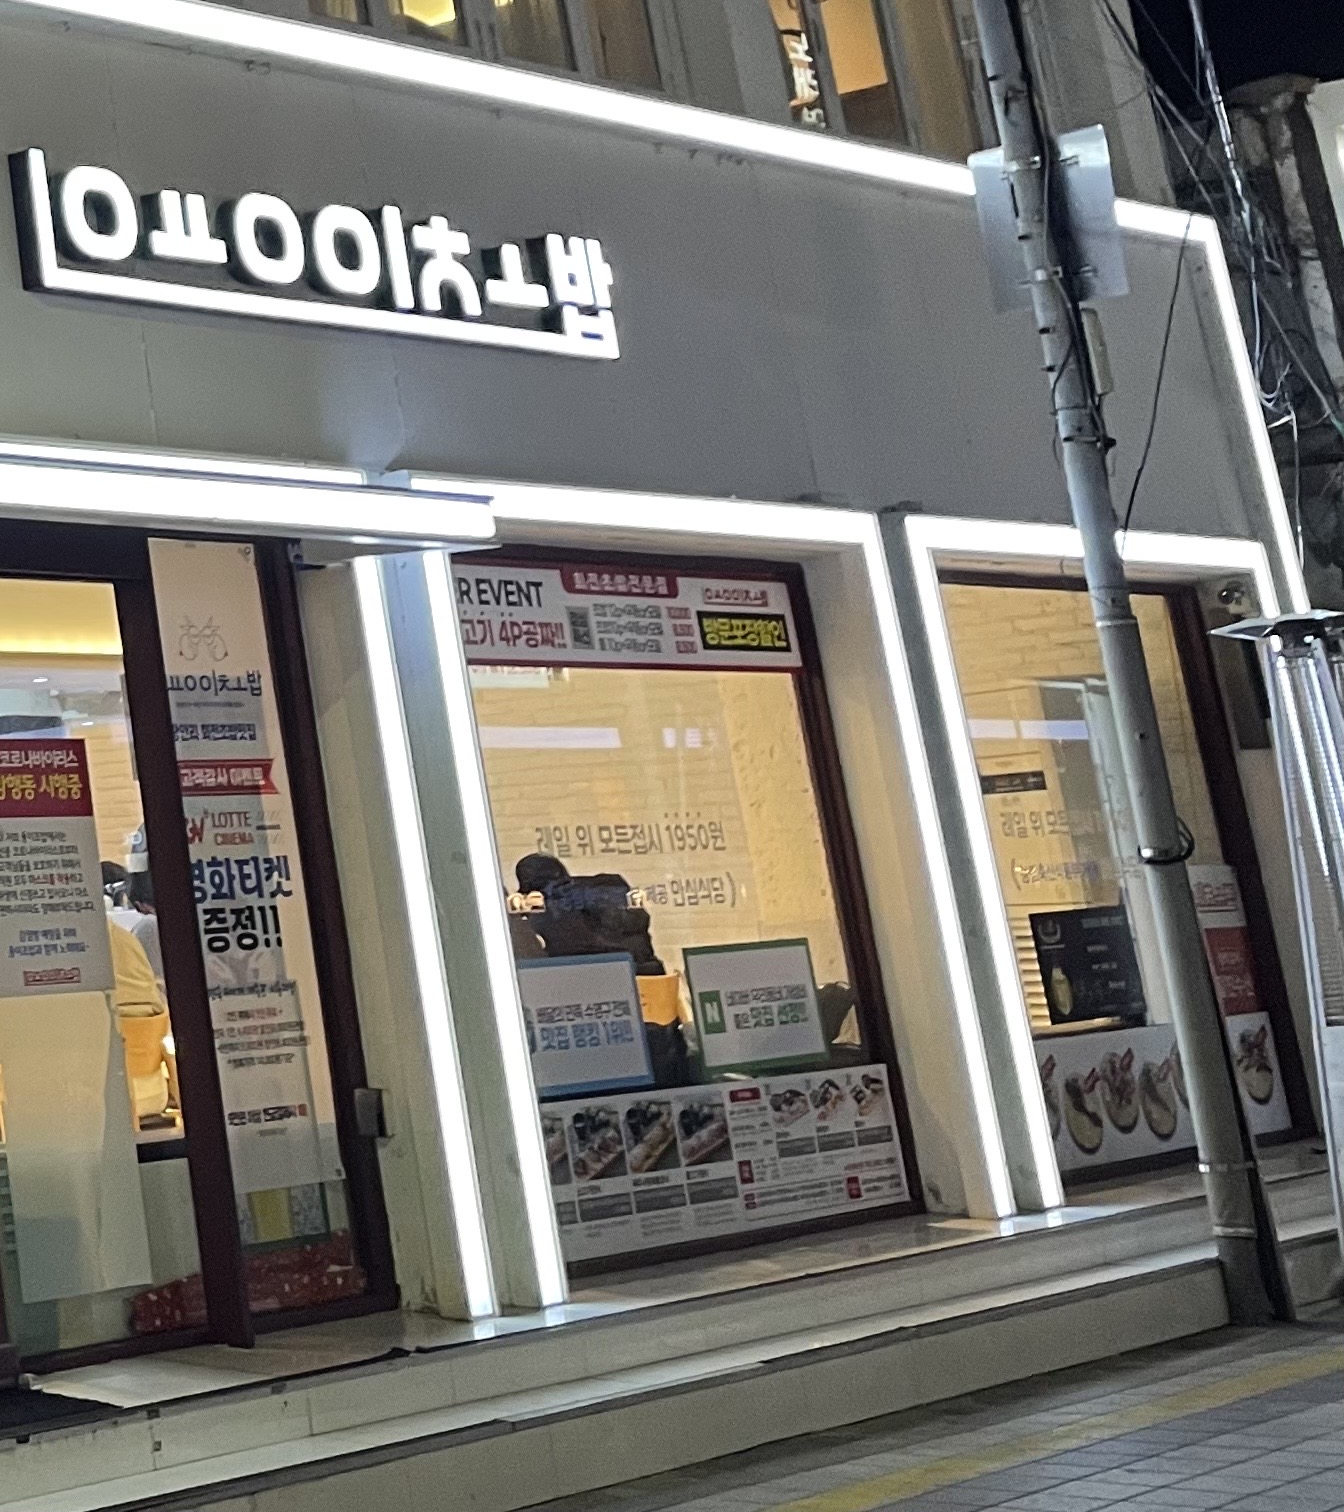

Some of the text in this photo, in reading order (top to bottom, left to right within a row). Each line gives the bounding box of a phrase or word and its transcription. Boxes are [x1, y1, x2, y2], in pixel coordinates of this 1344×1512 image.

[475, 577, 543, 608] EVENT
[0, 749, 80, 769] 코로나바이러스
[211, 811, 252, 829] LOTTE
[214, 831, 255, 846] CINEMA
[575, 824, 595, 856] 위
[598, 822, 663, 855] 모든접시
[664, 820, 727, 853] 1950원
[202, 904, 283, 953] 증정!!
